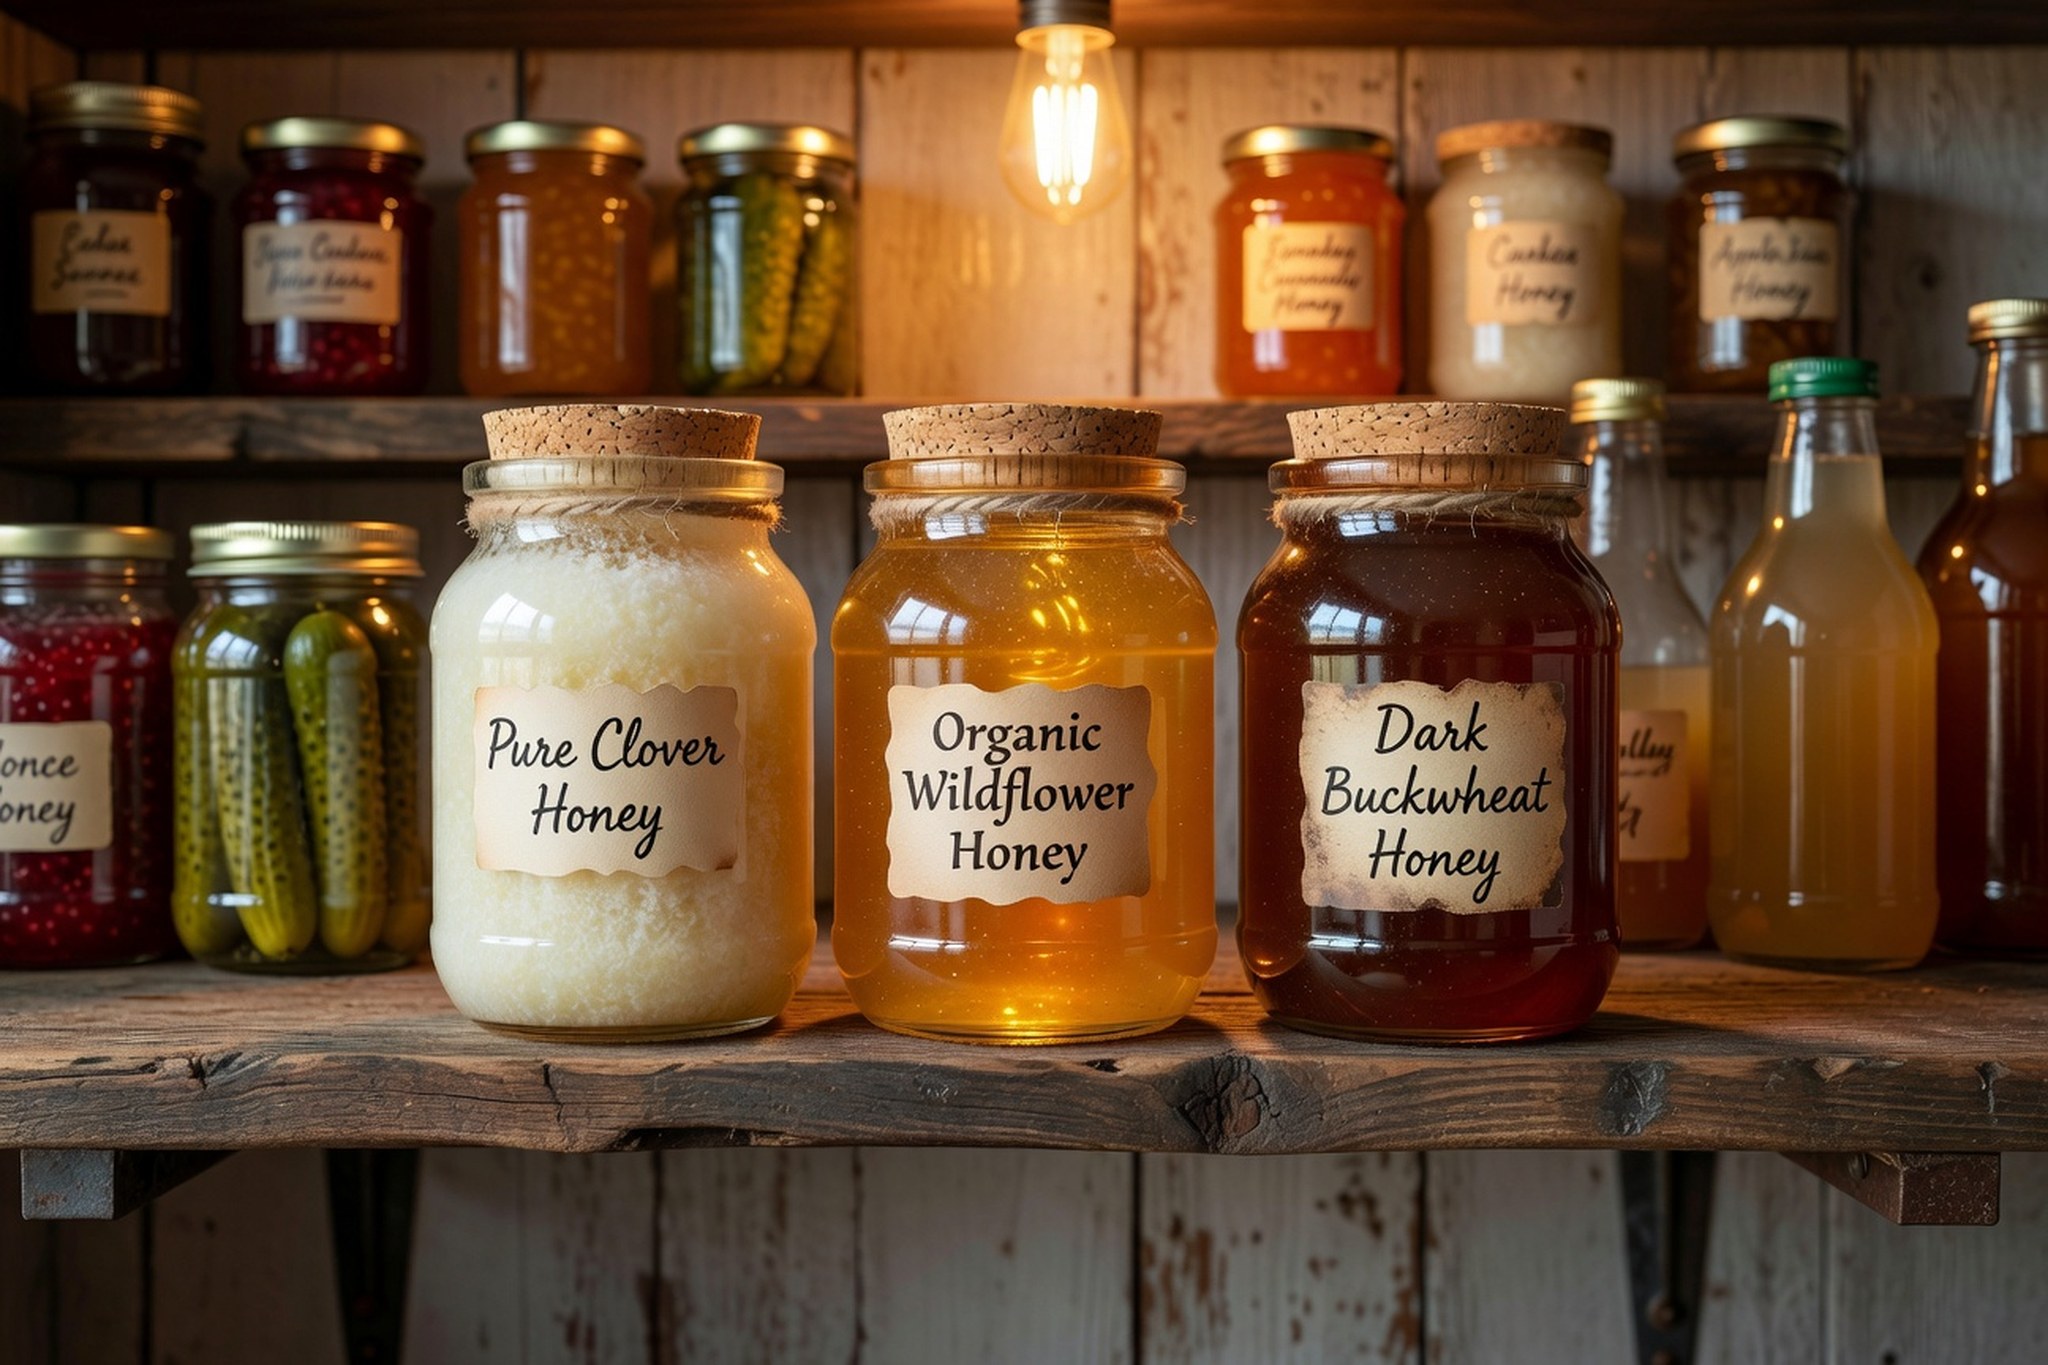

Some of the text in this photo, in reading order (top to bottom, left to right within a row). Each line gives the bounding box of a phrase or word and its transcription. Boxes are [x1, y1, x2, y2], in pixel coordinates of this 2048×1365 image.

[487, 716, 726, 772] Pure Clover
[932, 711, 1102, 766] Organic
[1374, 700, 1489, 754] Dark
[0, 738, 80, 778] once
[901, 765, 1135, 827] Wildflower
[1321, 763, 1552, 816] Buckwheat
[0, 800, 76, 845] oney
[531, 781, 663, 860] Honey
[949, 830, 1089, 885] Honey
[1368, 827, 1502, 904] Honey
